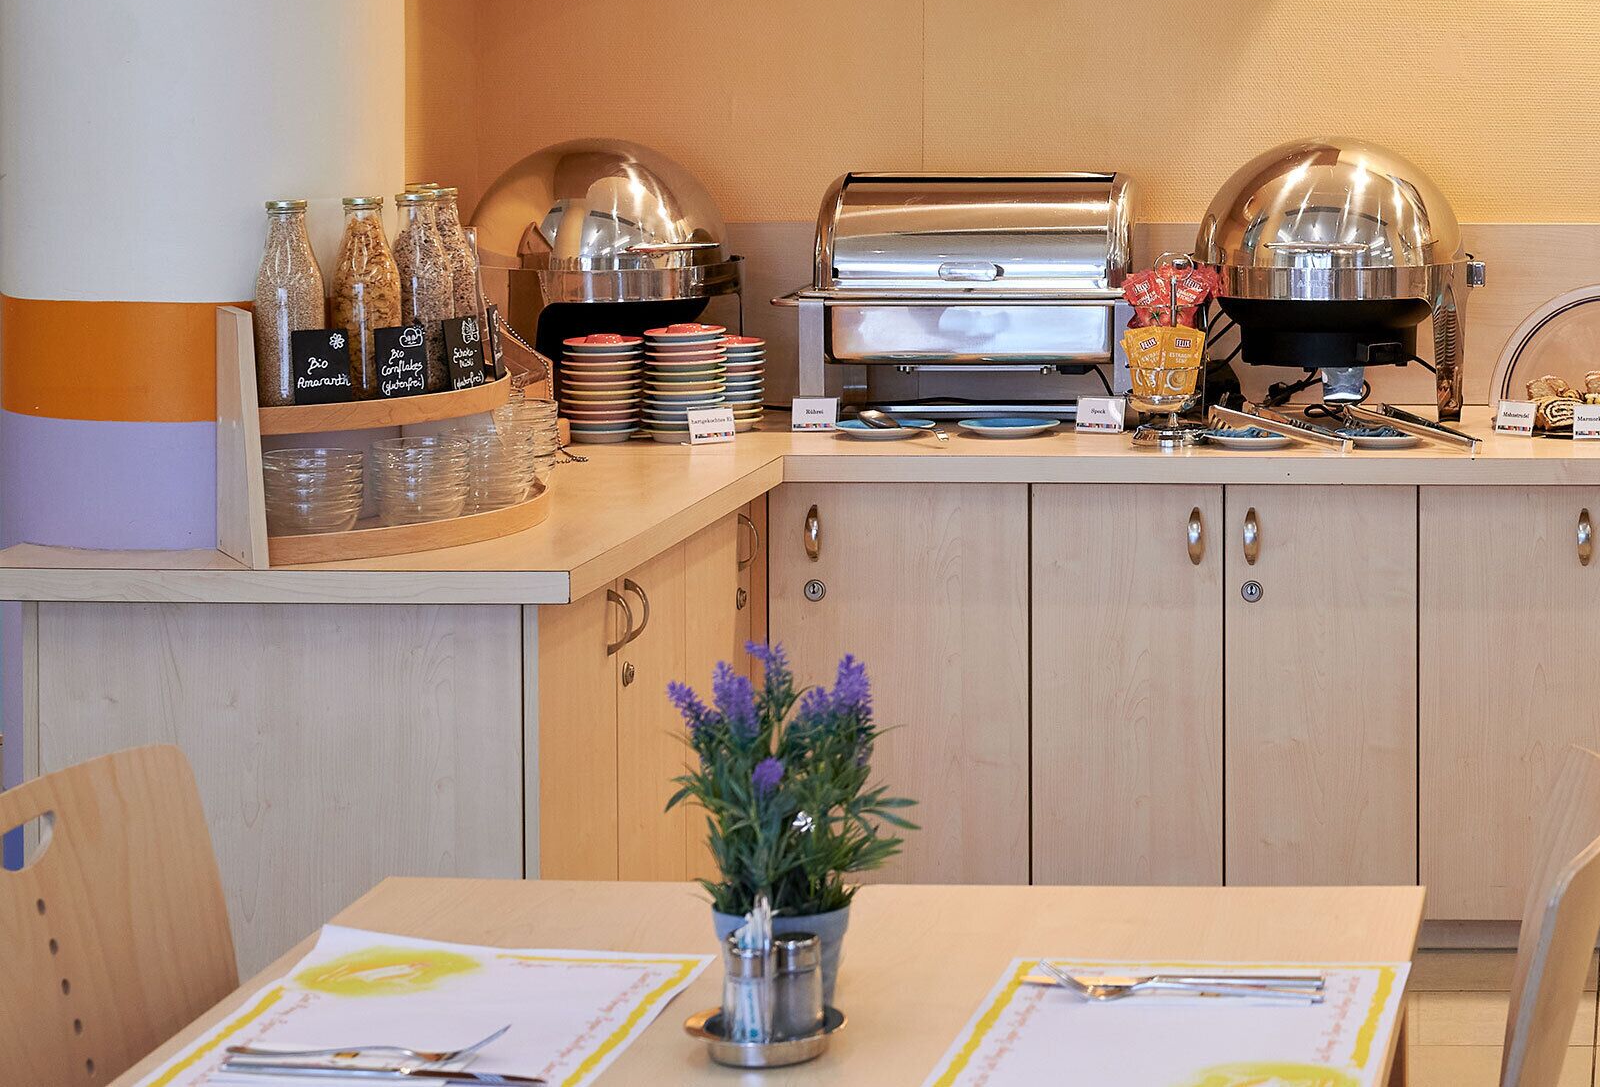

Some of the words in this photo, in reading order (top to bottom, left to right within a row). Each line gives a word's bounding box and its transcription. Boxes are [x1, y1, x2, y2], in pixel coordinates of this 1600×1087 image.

[1140, 338, 1157, 350] FELIX
[1176, 338, 1191, 348] FELIX
[389, 348, 405, 365] Bio
[308, 357, 329, 375] Bio
[381, 359, 424, 380] Cornflakes
[297, 372, 352, 389] Amaranth
[381, 374, 426, 396] (glutenfrei)
